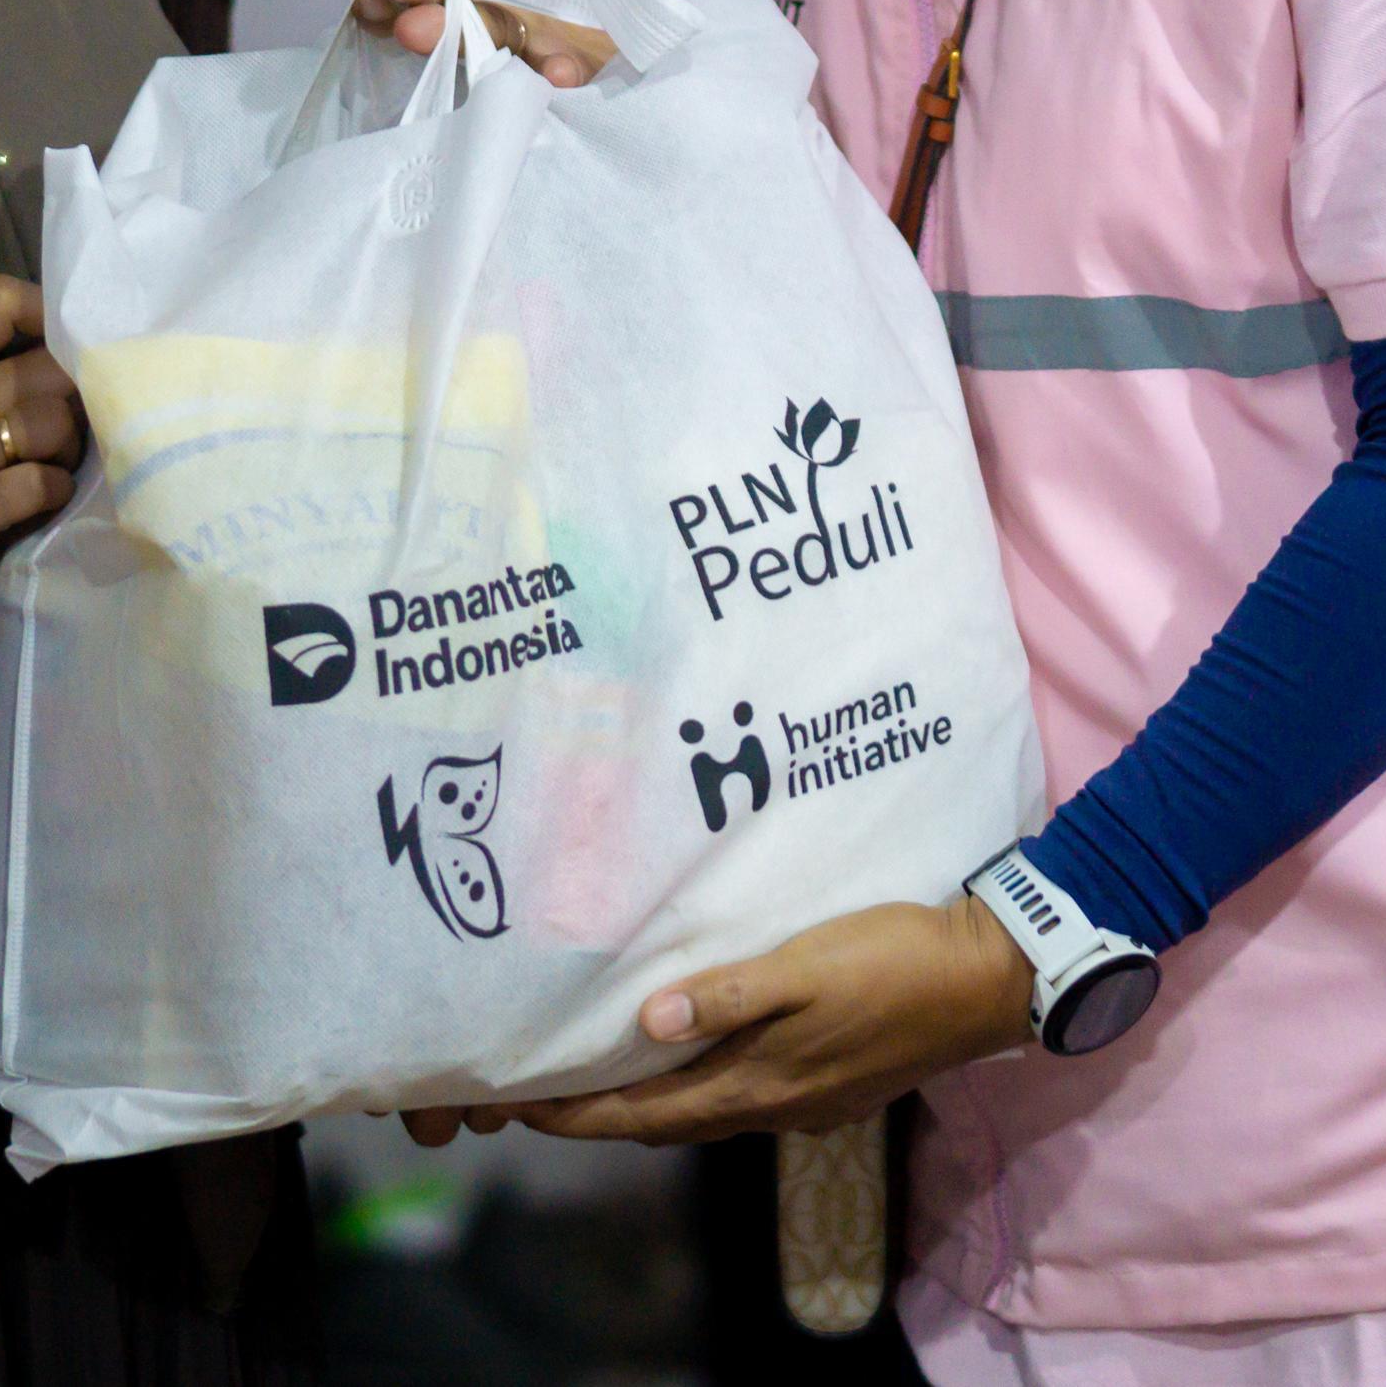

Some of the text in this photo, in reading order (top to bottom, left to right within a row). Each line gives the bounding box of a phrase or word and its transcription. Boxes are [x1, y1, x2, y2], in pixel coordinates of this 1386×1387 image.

[669, 463, 797, 550] PLN
[692, 462, 913, 621] Peduli
[368, 562, 576, 639] Danantara
[375, 609, 584, 697] Indonesia
[778, 681, 916, 754] human
[787, 716, 952, 798] initiative
